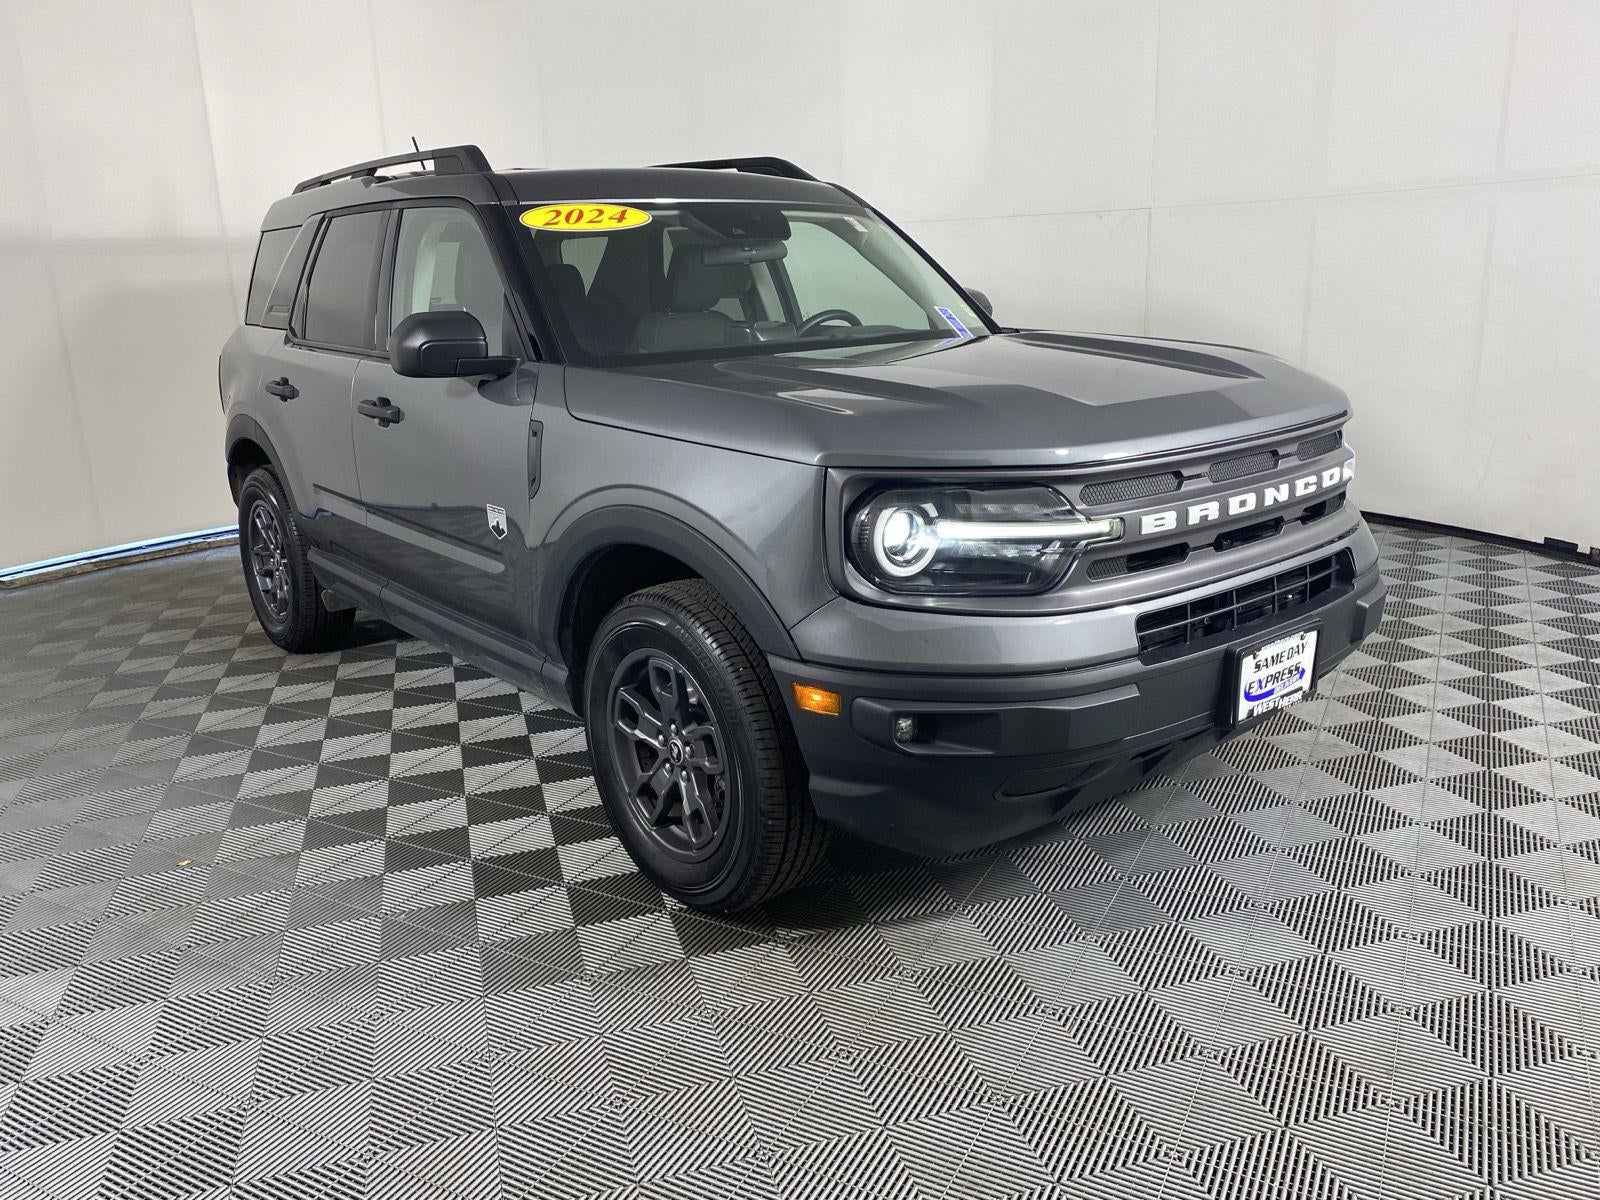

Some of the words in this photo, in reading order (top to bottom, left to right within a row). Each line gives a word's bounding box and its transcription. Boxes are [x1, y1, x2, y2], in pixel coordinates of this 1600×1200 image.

[542, 208, 628, 226] 2024
[1140, 466, 1341, 535] BRONCO
[1253, 650, 1287, 674] SAME
[1287, 641, 1308, 660] DAY
[1247, 661, 1302, 695] EXPRESS
